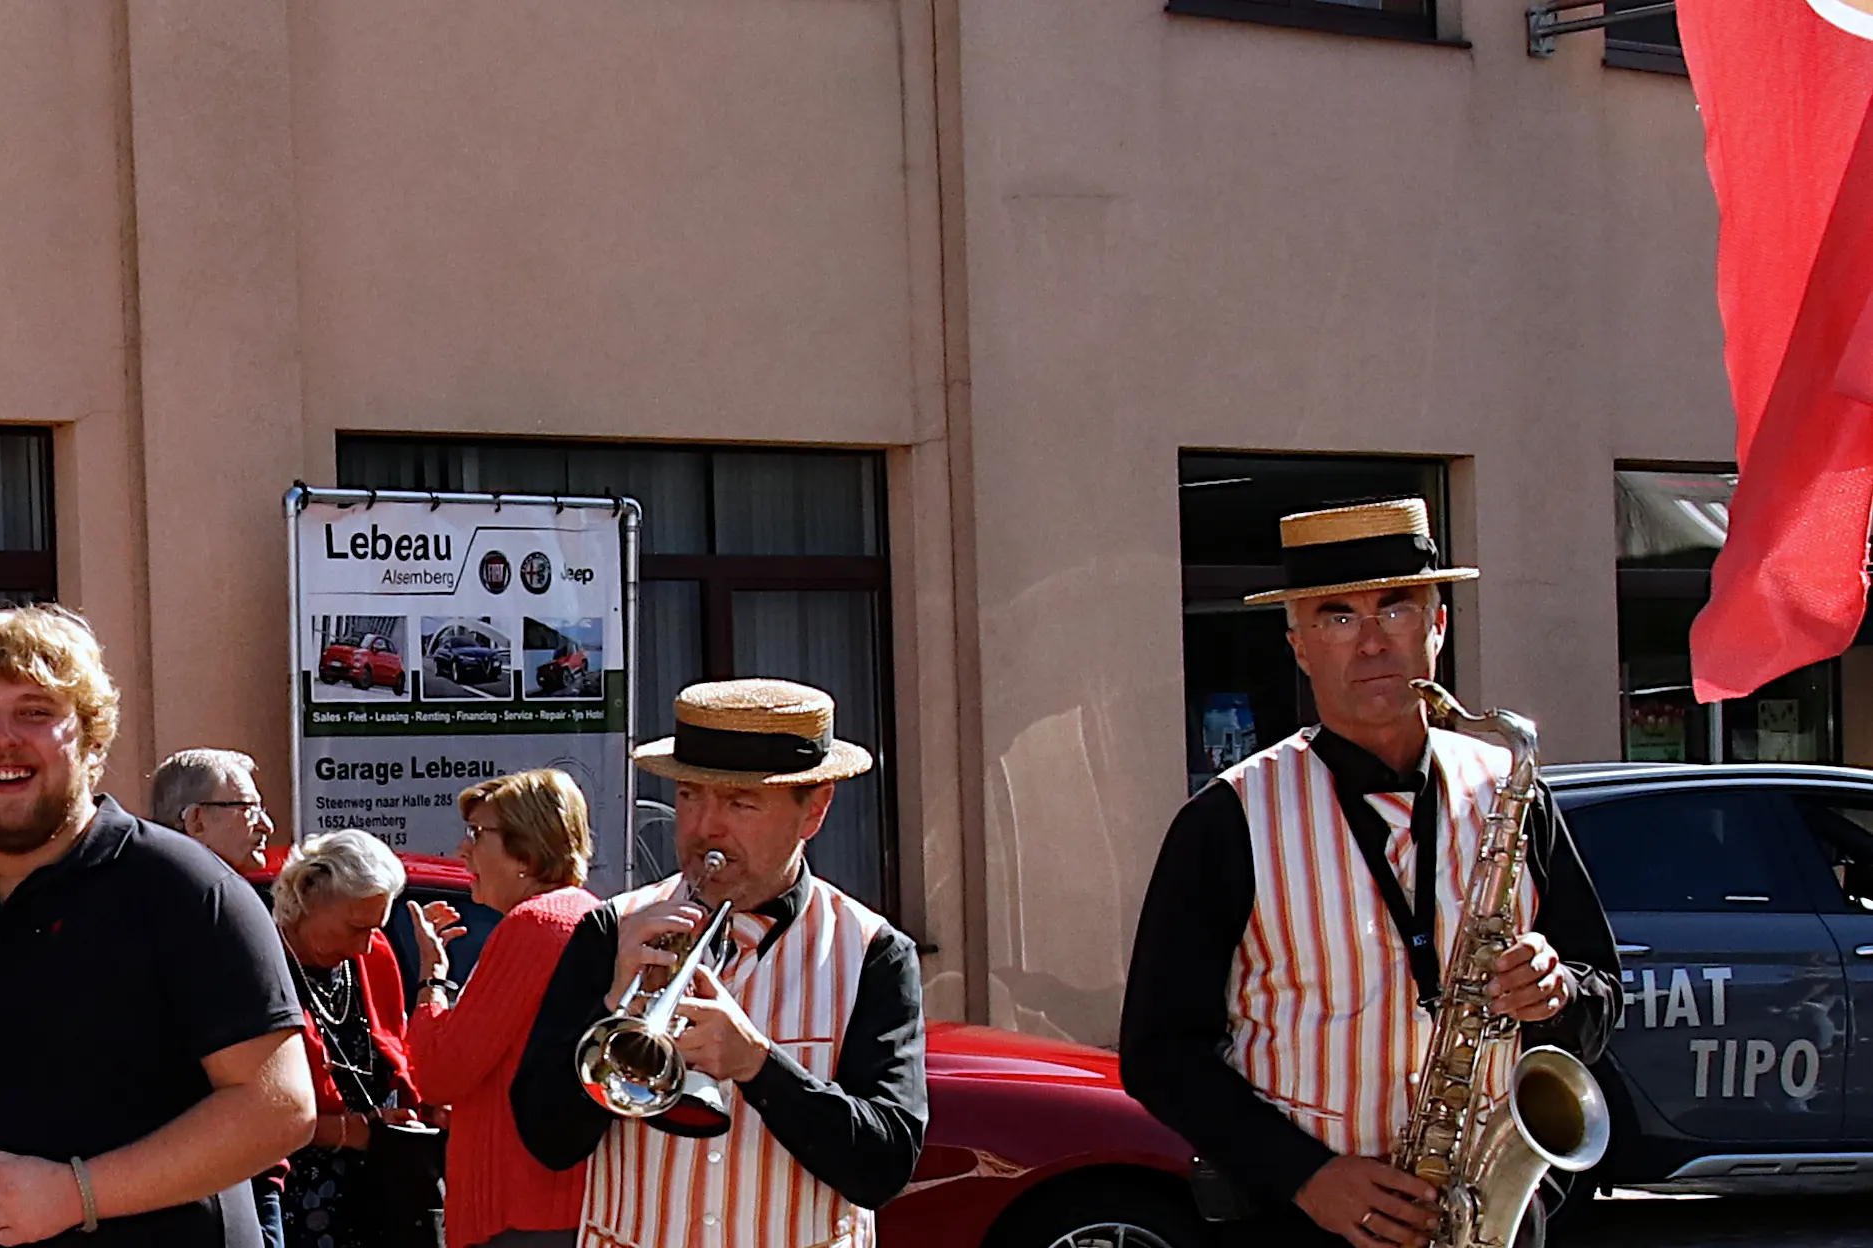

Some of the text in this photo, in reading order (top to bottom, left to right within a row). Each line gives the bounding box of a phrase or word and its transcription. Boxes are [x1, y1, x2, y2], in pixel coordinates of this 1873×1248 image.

[325, 523, 452, 561] Lebeau
[381, 568, 454, 589] Alsemberg
[560, 562, 594, 585] Jeep
[312, 711, 341, 722] Sales
[375, 711, 409, 724] Leasing
[415, 711, 450, 724] Renting
[456, 710, 497, 723] Financing
[504, 709, 533, 720] Service
[540, 709, 567, 722] Repair
[315, 756, 495, 785] Garage Lebeau
[316, 794, 453, 811] Steenweg naar Halle 285
[318, 815, 406, 829] 1652 Alsemberg
[1689, 1038, 1820, 1099] TIPO
